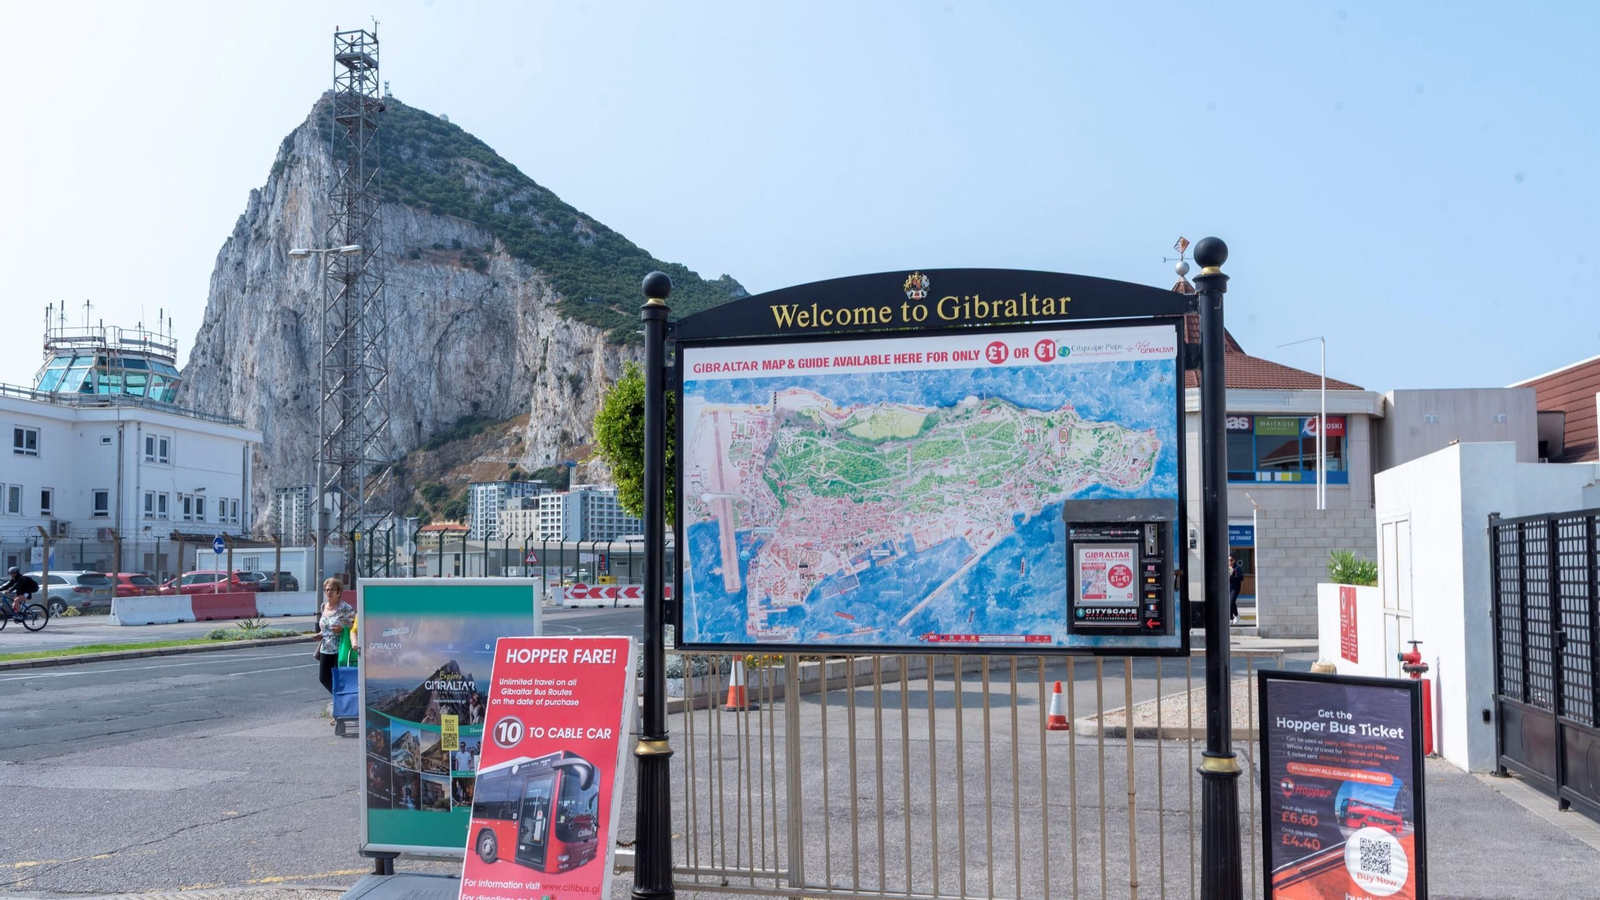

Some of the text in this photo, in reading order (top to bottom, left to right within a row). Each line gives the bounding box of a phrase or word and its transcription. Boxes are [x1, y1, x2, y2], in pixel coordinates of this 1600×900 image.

[770, 292, 1071, 329] Welcome to Gibraltar
[693, 342, 1054, 374] GIBRALTAR MAP & GUIDE AVAILABLE HERE FOR ONLY £1 OR €1
[506, 649, 617, 664] HOPPER FARE!
[440, 670, 462, 680] Explore
[499, 678, 532, 686] Unlimited
[425, 680, 475, 691] GIBRALTAR
[544, 699, 579, 707] purchase
[1318, 709, 1352, 720] Get the
[498, 722, 612, 743] 10 TO CABLE CAR
[1276, 716, 1404, 739] Hopper Bus Ticket
[1332, 770, 1356, 778] Gibraltar
[1295, 785, 1332, 798] Hopper
[1282, 811, 1319, 827] £6.60
[1282, 833, 1321, 851] £4.40
[1356, 872, 1397, 886] Buy Now
[464, 879, 477, 887] For
[525, 882, 540, 890] visit
[542, 883, 600, 895] www.citibus.gi
